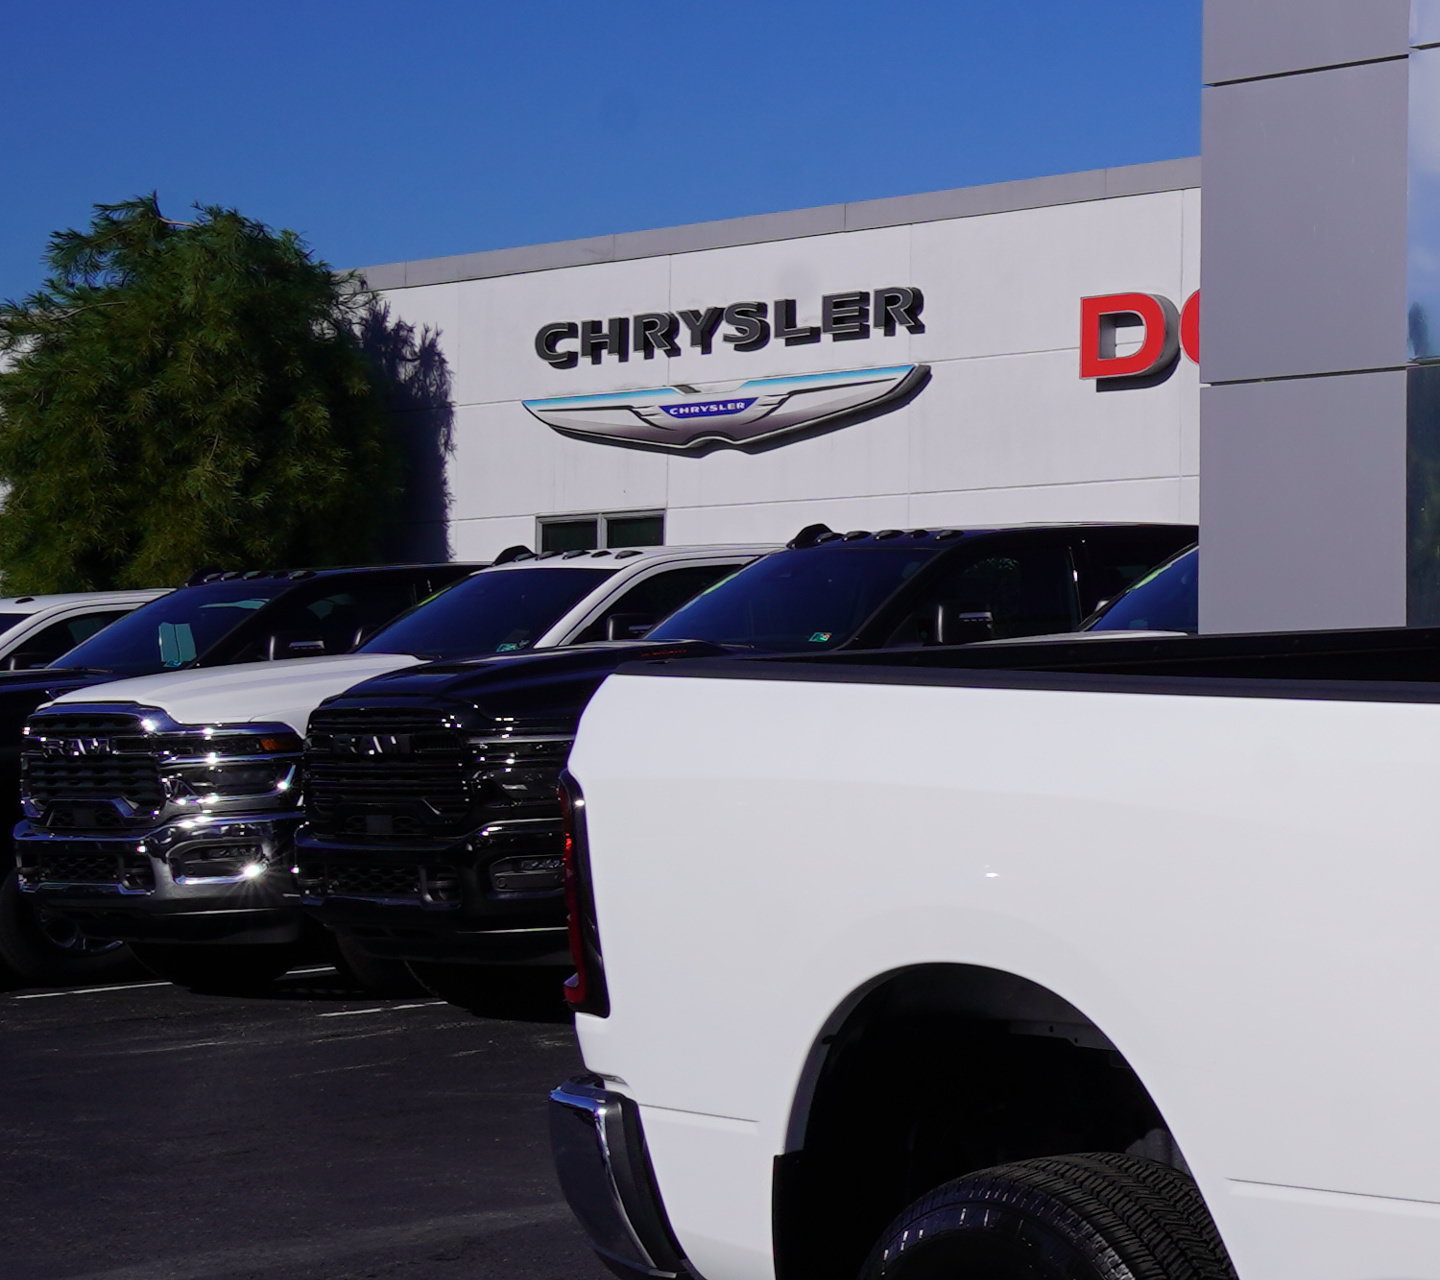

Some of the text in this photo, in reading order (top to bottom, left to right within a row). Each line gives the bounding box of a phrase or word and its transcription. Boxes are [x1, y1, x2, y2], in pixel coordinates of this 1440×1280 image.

[534, 286, 925, 368] CHRYSLER
[1079, 287, 1200, 380] D
[669, 402, 745, 415] CHRYSLER
